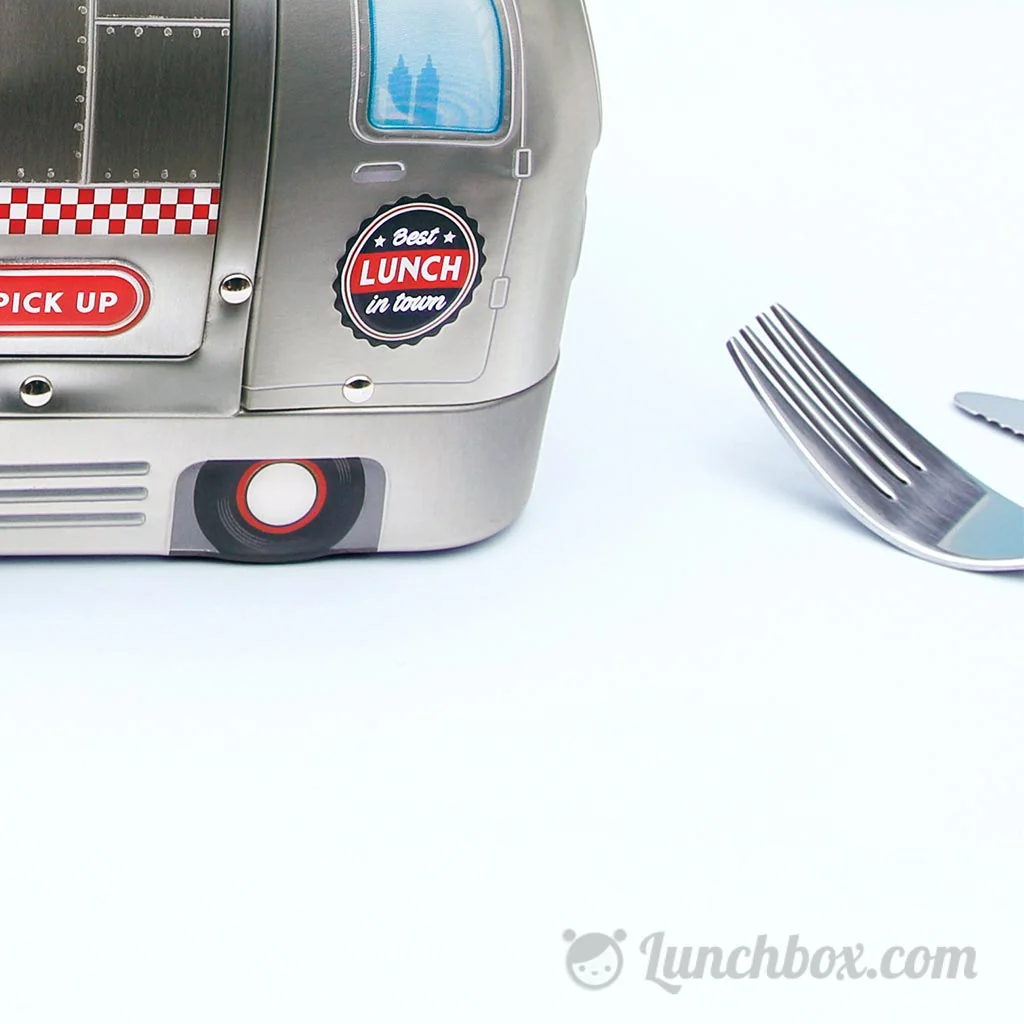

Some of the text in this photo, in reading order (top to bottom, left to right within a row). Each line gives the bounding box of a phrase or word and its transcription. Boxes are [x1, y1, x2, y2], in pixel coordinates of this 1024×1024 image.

[393, 227, 440, 246] Best
[359, 255, 462, 286] LUNCH
[75, 292, 119, 315] UP
[365, 293, 446, 315] in town
